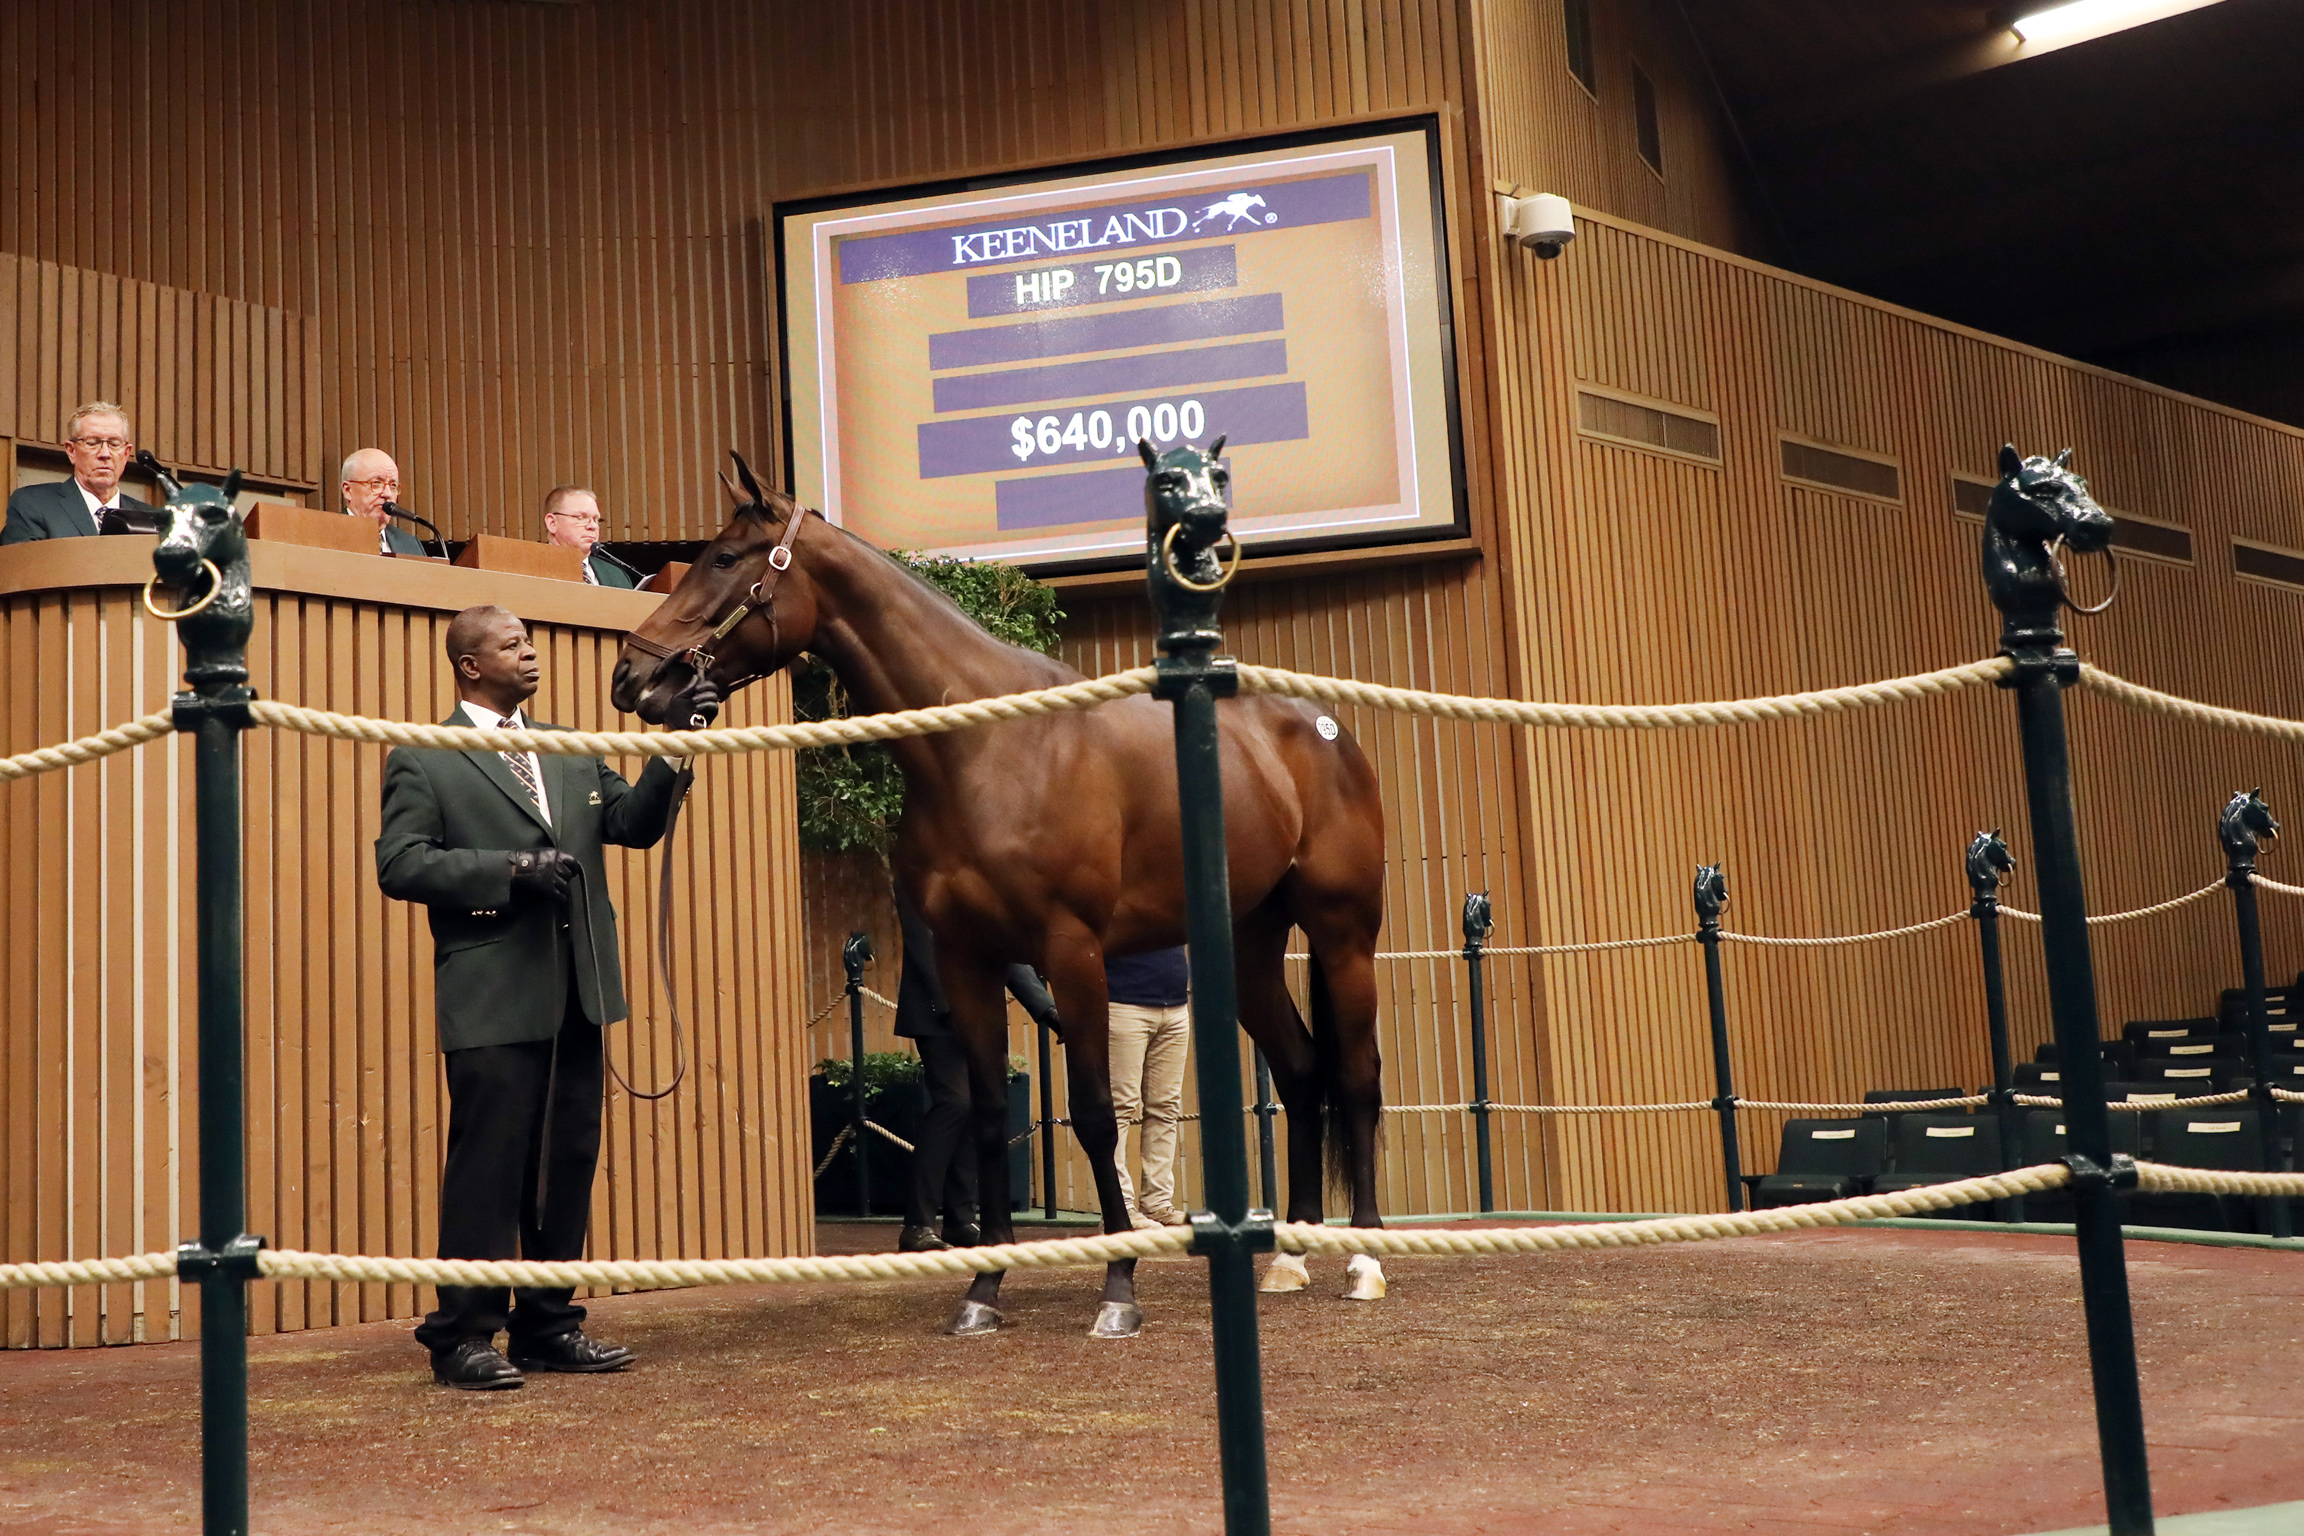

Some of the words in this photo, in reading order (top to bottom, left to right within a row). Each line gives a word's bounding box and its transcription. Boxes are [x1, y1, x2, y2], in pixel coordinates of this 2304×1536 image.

[952, 207, 1188, 264] KEENELAND
[1015, 269, 1075, 304] HIP
[1094, 256, 1182, 294] 795D
[1011, 400, 1205, 461] $640,000
